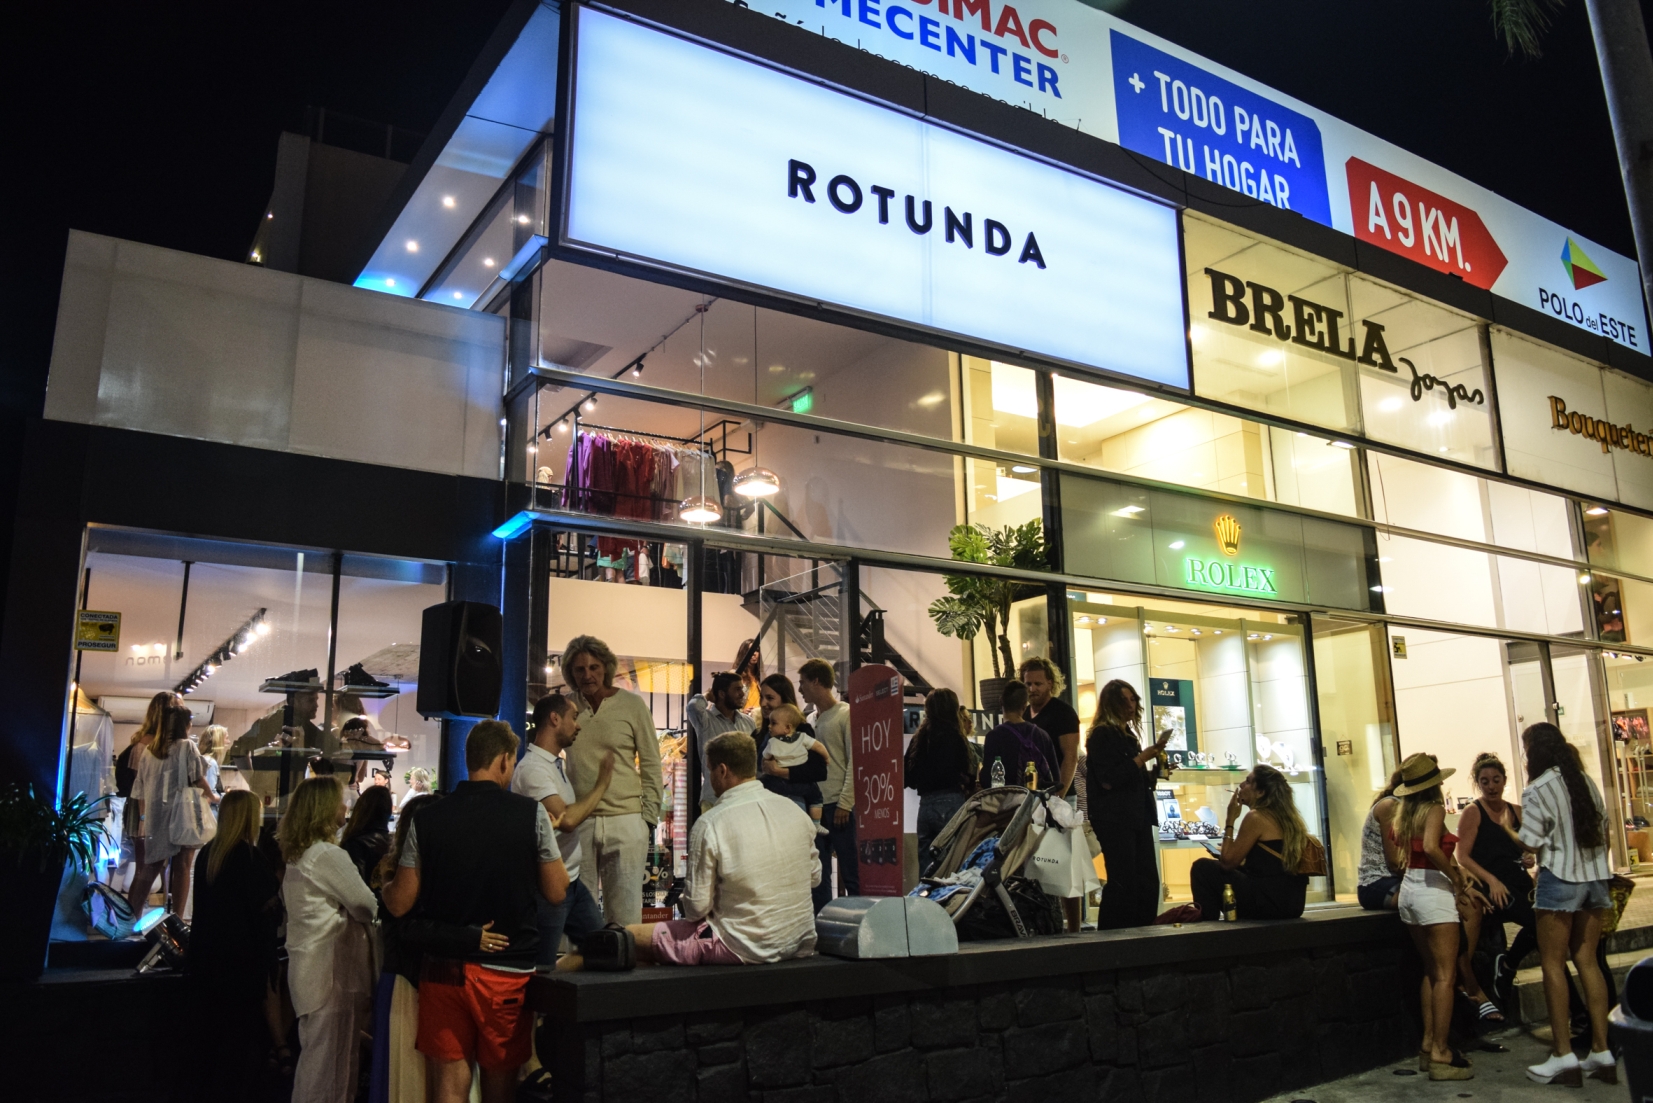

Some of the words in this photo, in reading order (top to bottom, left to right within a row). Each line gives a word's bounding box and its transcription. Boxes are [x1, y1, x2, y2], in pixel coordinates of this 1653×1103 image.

[1153, 70, 1226, 136] TODO
[1233, 105, 1301, 169] PARA
[1157, 126, 1196, 175] TU
[1203, 144, 1291, 210] HOGAR
[787, 157, 1047, 270] ROTUNDA
[1419, 201, 1471, 273] KM.
[1203, 267, 1398, 373] BRELA
[1538, 287, 1584, 325] POLO
[1585, 315, 1599, 331] del
[1599, 313, 1638, 347] ESTE
[1546, 395, 1653, 460] Bouqueter
[1185, 557, 1278, 595] ROLEX
[861, 718, 891, 754] HOY
[862, 772, 894, 815] 30%
[1032, 856, 1059, 864] ROTUNDA
